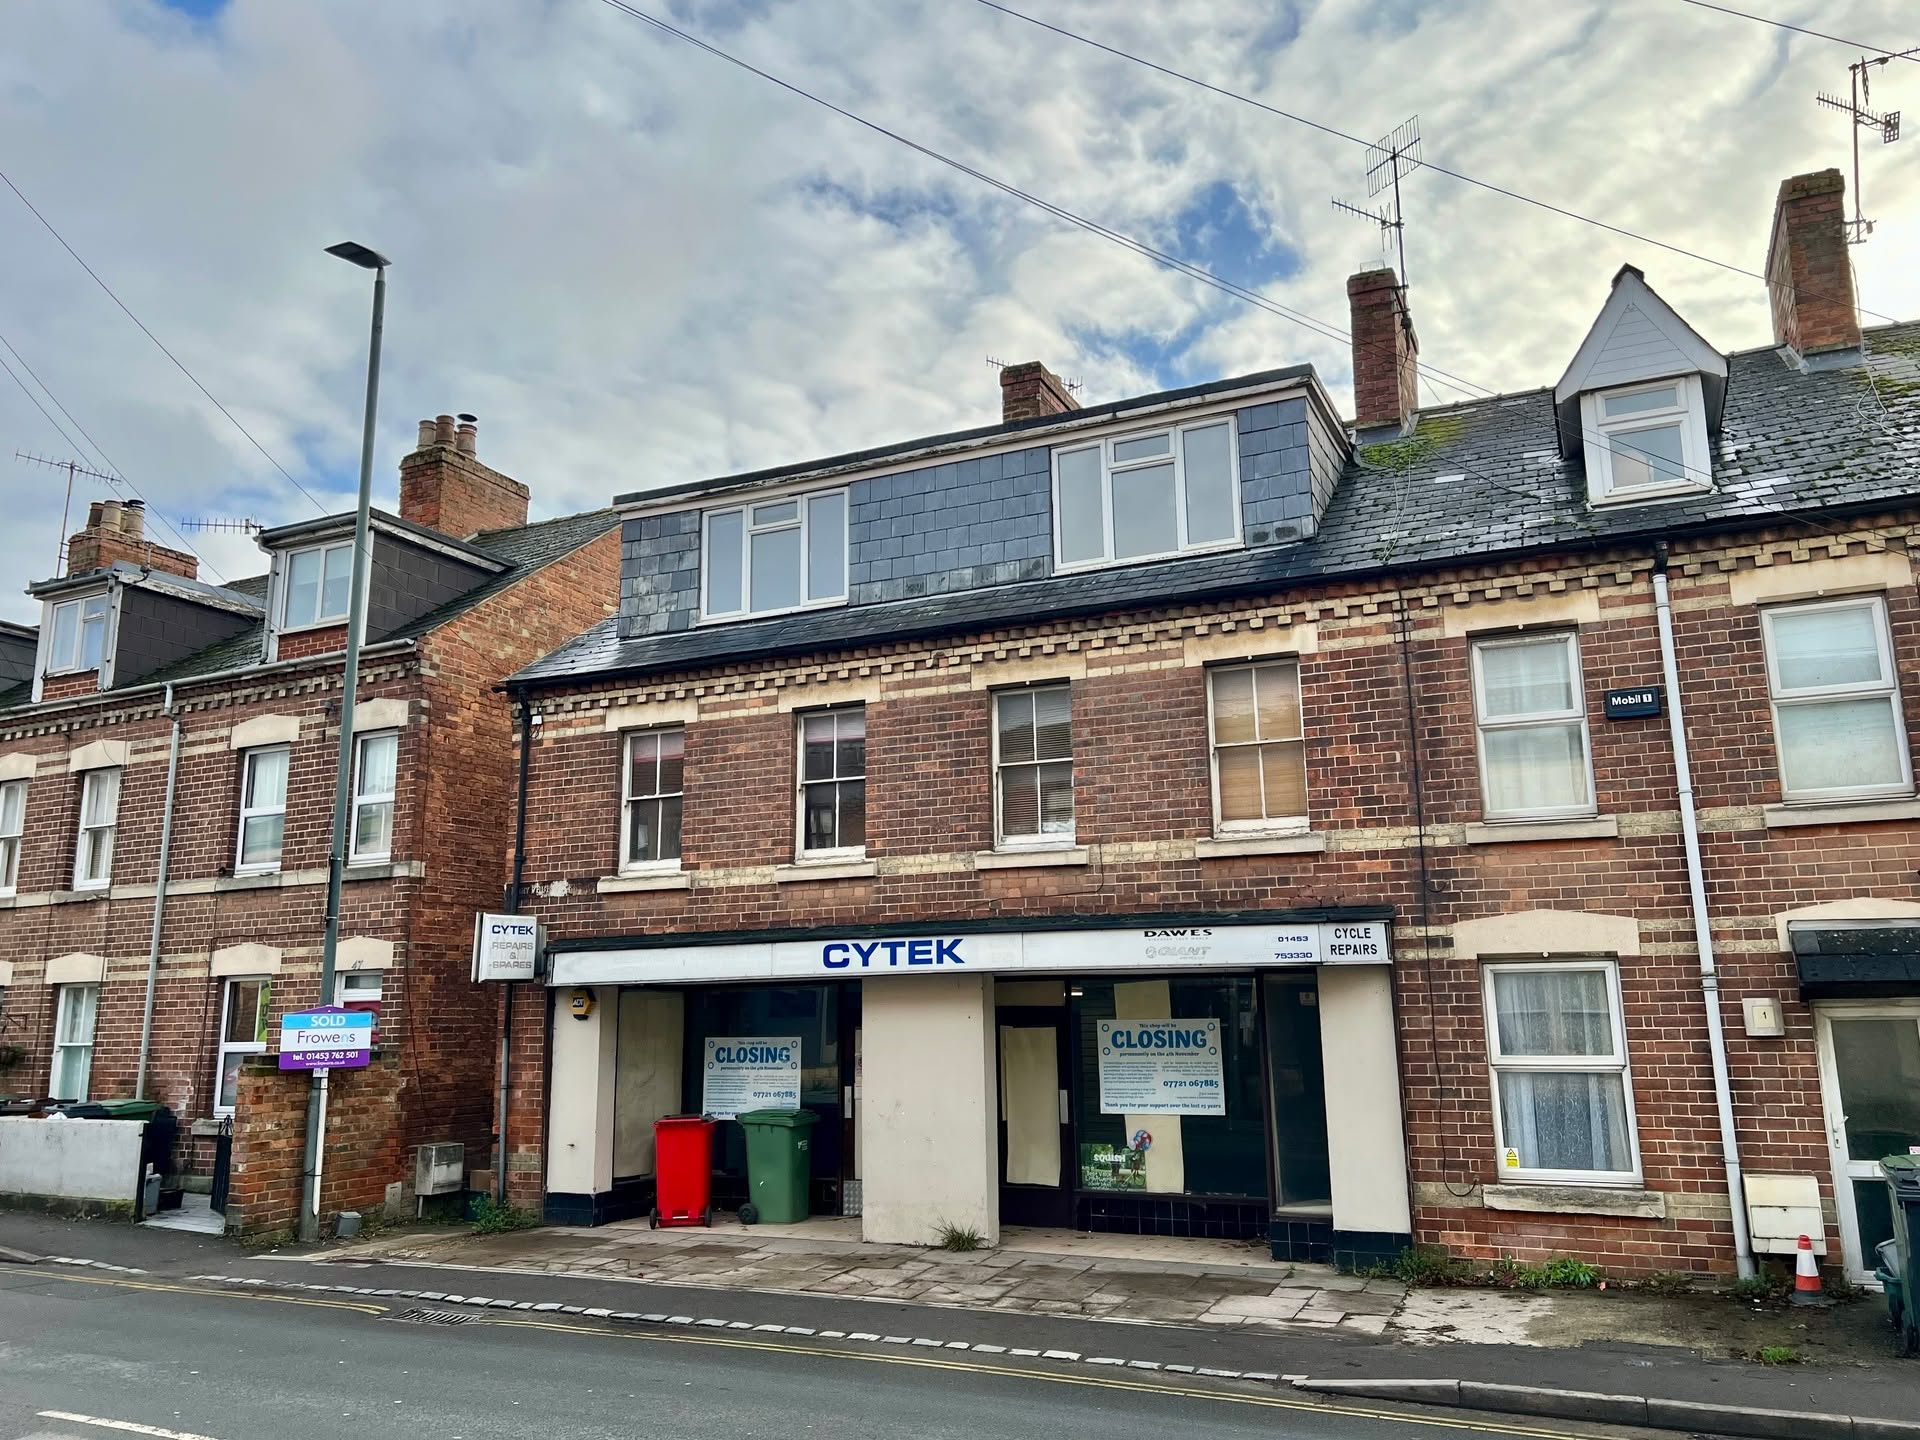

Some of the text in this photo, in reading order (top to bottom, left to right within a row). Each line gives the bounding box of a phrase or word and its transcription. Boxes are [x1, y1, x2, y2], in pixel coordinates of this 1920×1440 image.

[1611, 694, 1641, 705] Mobil
[492, 924, 534, 935] CYTEK
[1144, 928, 1213, 937] DAWES
[1334, 927, 1371, 939] CYCLE
[491, 941, 534, 950] REPAIRS
[1330, 943, 1378, 955] REPAIRS
[509, 951, 517, 960] &
[823, 938, 965, 968] CYTEK
[492, 961, 532, 969] SPARES
[311, 1015, 346, 1027] SOLD
[297, 1030, 355, 1044] Frowens
[1111, 1030, 1207, 1049] CLOSING
[293, 1050, 358, 1061] tel. 01453 762 501
[715, 1046, 790, 1063] CLOSING
[1163, 1079, 1219, 1088] 07721 067885
[753, 1091, 797, 1099] 07721 067885
